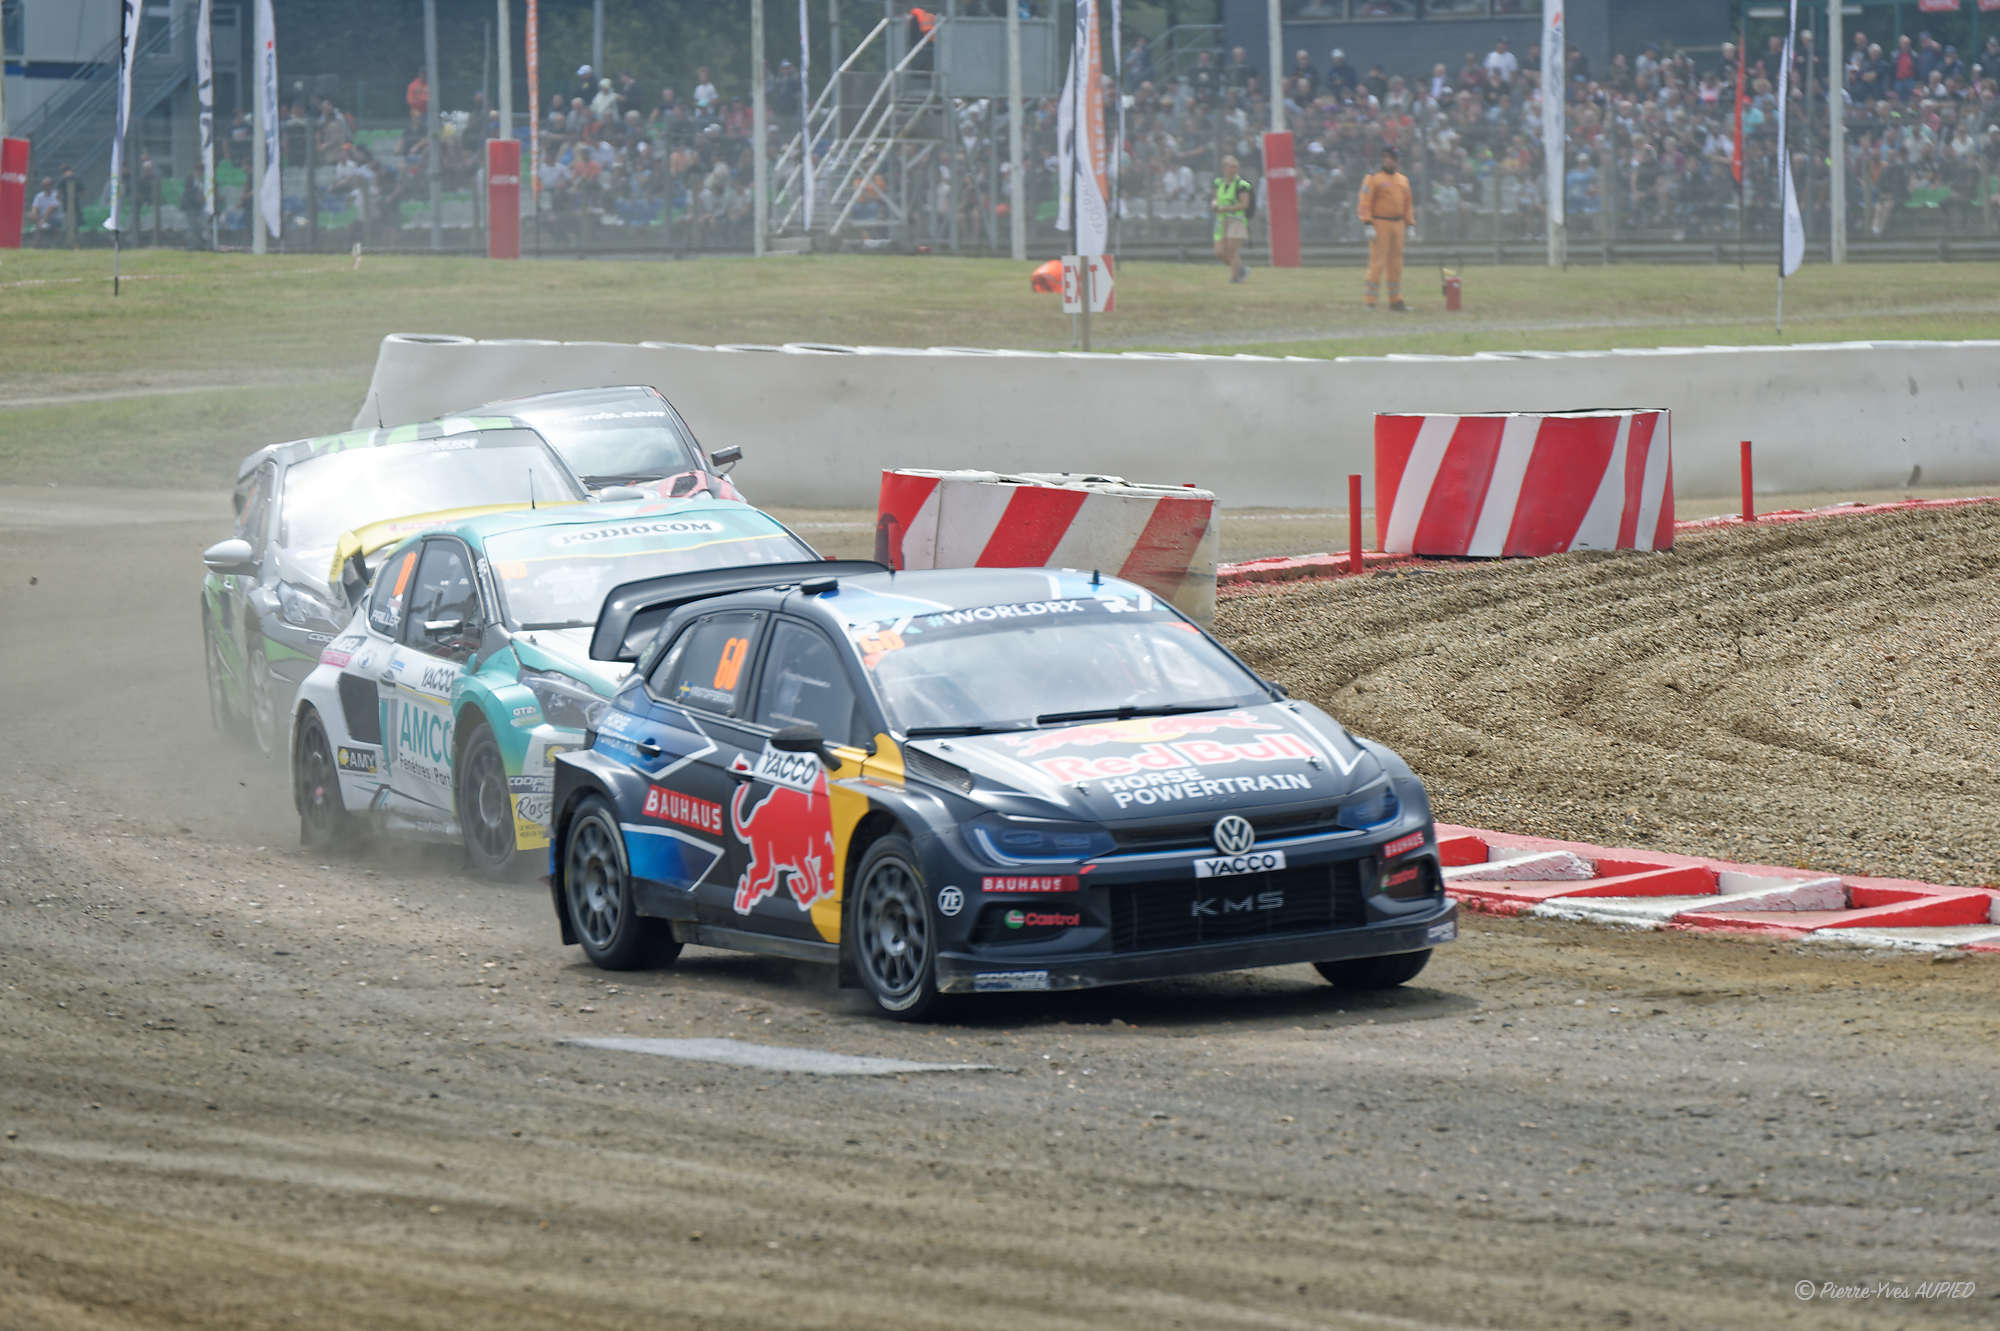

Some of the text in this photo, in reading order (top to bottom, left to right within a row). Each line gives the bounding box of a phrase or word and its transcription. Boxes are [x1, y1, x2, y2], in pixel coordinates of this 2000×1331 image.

[1064, 265, 1098, 303] EXT
[561, 521, 713, 545] PODIOCOM
[927, 600, 1085, 628] #WORLDRX
[713, 637, 749, 691] 60
[421, 665, 455, 693] YACCO
[350, 752, 375, 771] AMY
[761, 751, 818, 784] YACCO
[1040, 734, 1316, 782] Red Bull
[1101, 767, 1206, 793] HORSE
[1112, 773, 1312, 808] POWERTRAIN
[645, 789, 722, 831] BAUHAUS
[1205, 854, 1276, 876] YACCO
[983, 878, 1062, 890] BAUHAUS
[940, 889, 963, 913] ZF
[1192, 891, 1285, 916] KMS
[1026, 912, 1080, 926] Castrol
